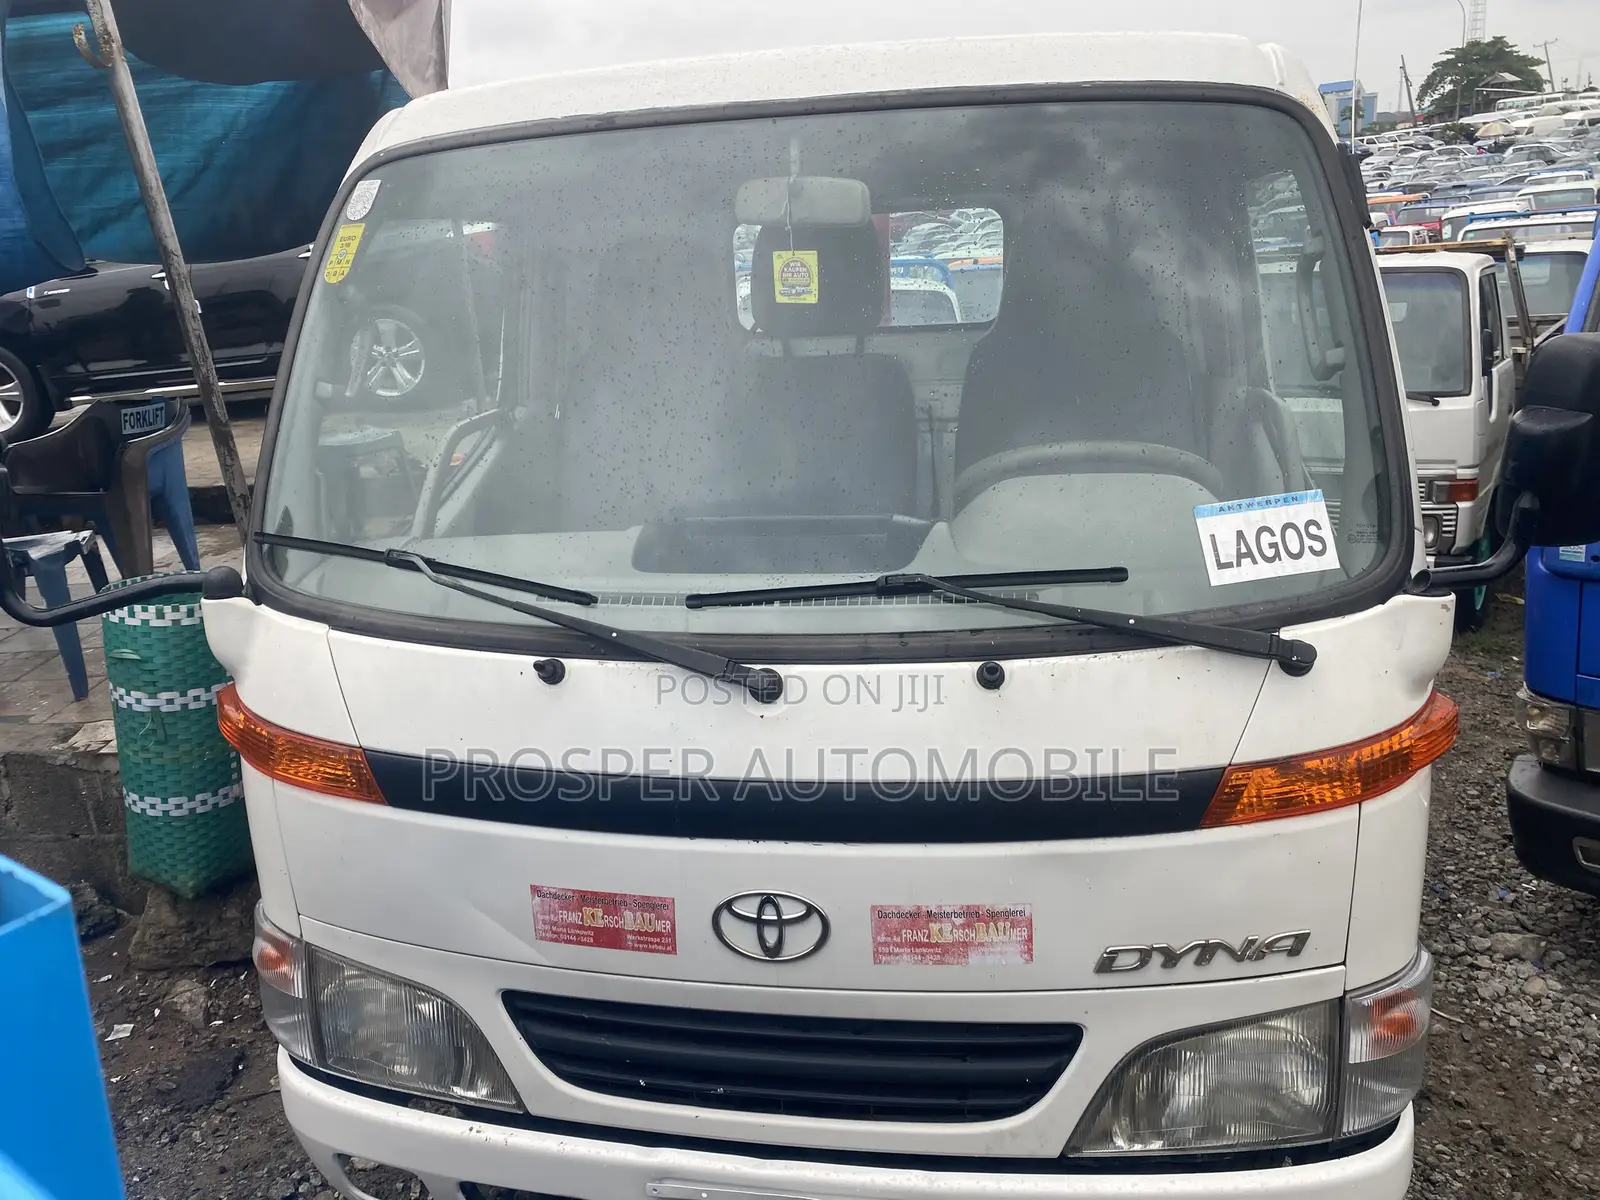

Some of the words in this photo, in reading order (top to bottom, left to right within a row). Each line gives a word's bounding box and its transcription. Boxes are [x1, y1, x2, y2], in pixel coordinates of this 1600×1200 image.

[122, 406, 164, 431] FORKLIFT
[1218, 495, 1299, 513] ANTWERPEN
[1209, 518, 1328, 571] LAGOS
[536, 889, 575, 901] Dachdecker
[580, 894, 628, 907] Meisterbetrieb
[632, 899, 669, 911] Spenglerei
[558, 910, 583, 925] FRANZ
[877, 909, 920, 919] Dachdecker
[926, 909, 980, 919] Meisterbetrieb
[985, 907, 1026, 919] Spenglerei
[901, 929, 930, 943] FRANZ
[1093, 929, 1312, 974] DYNA
